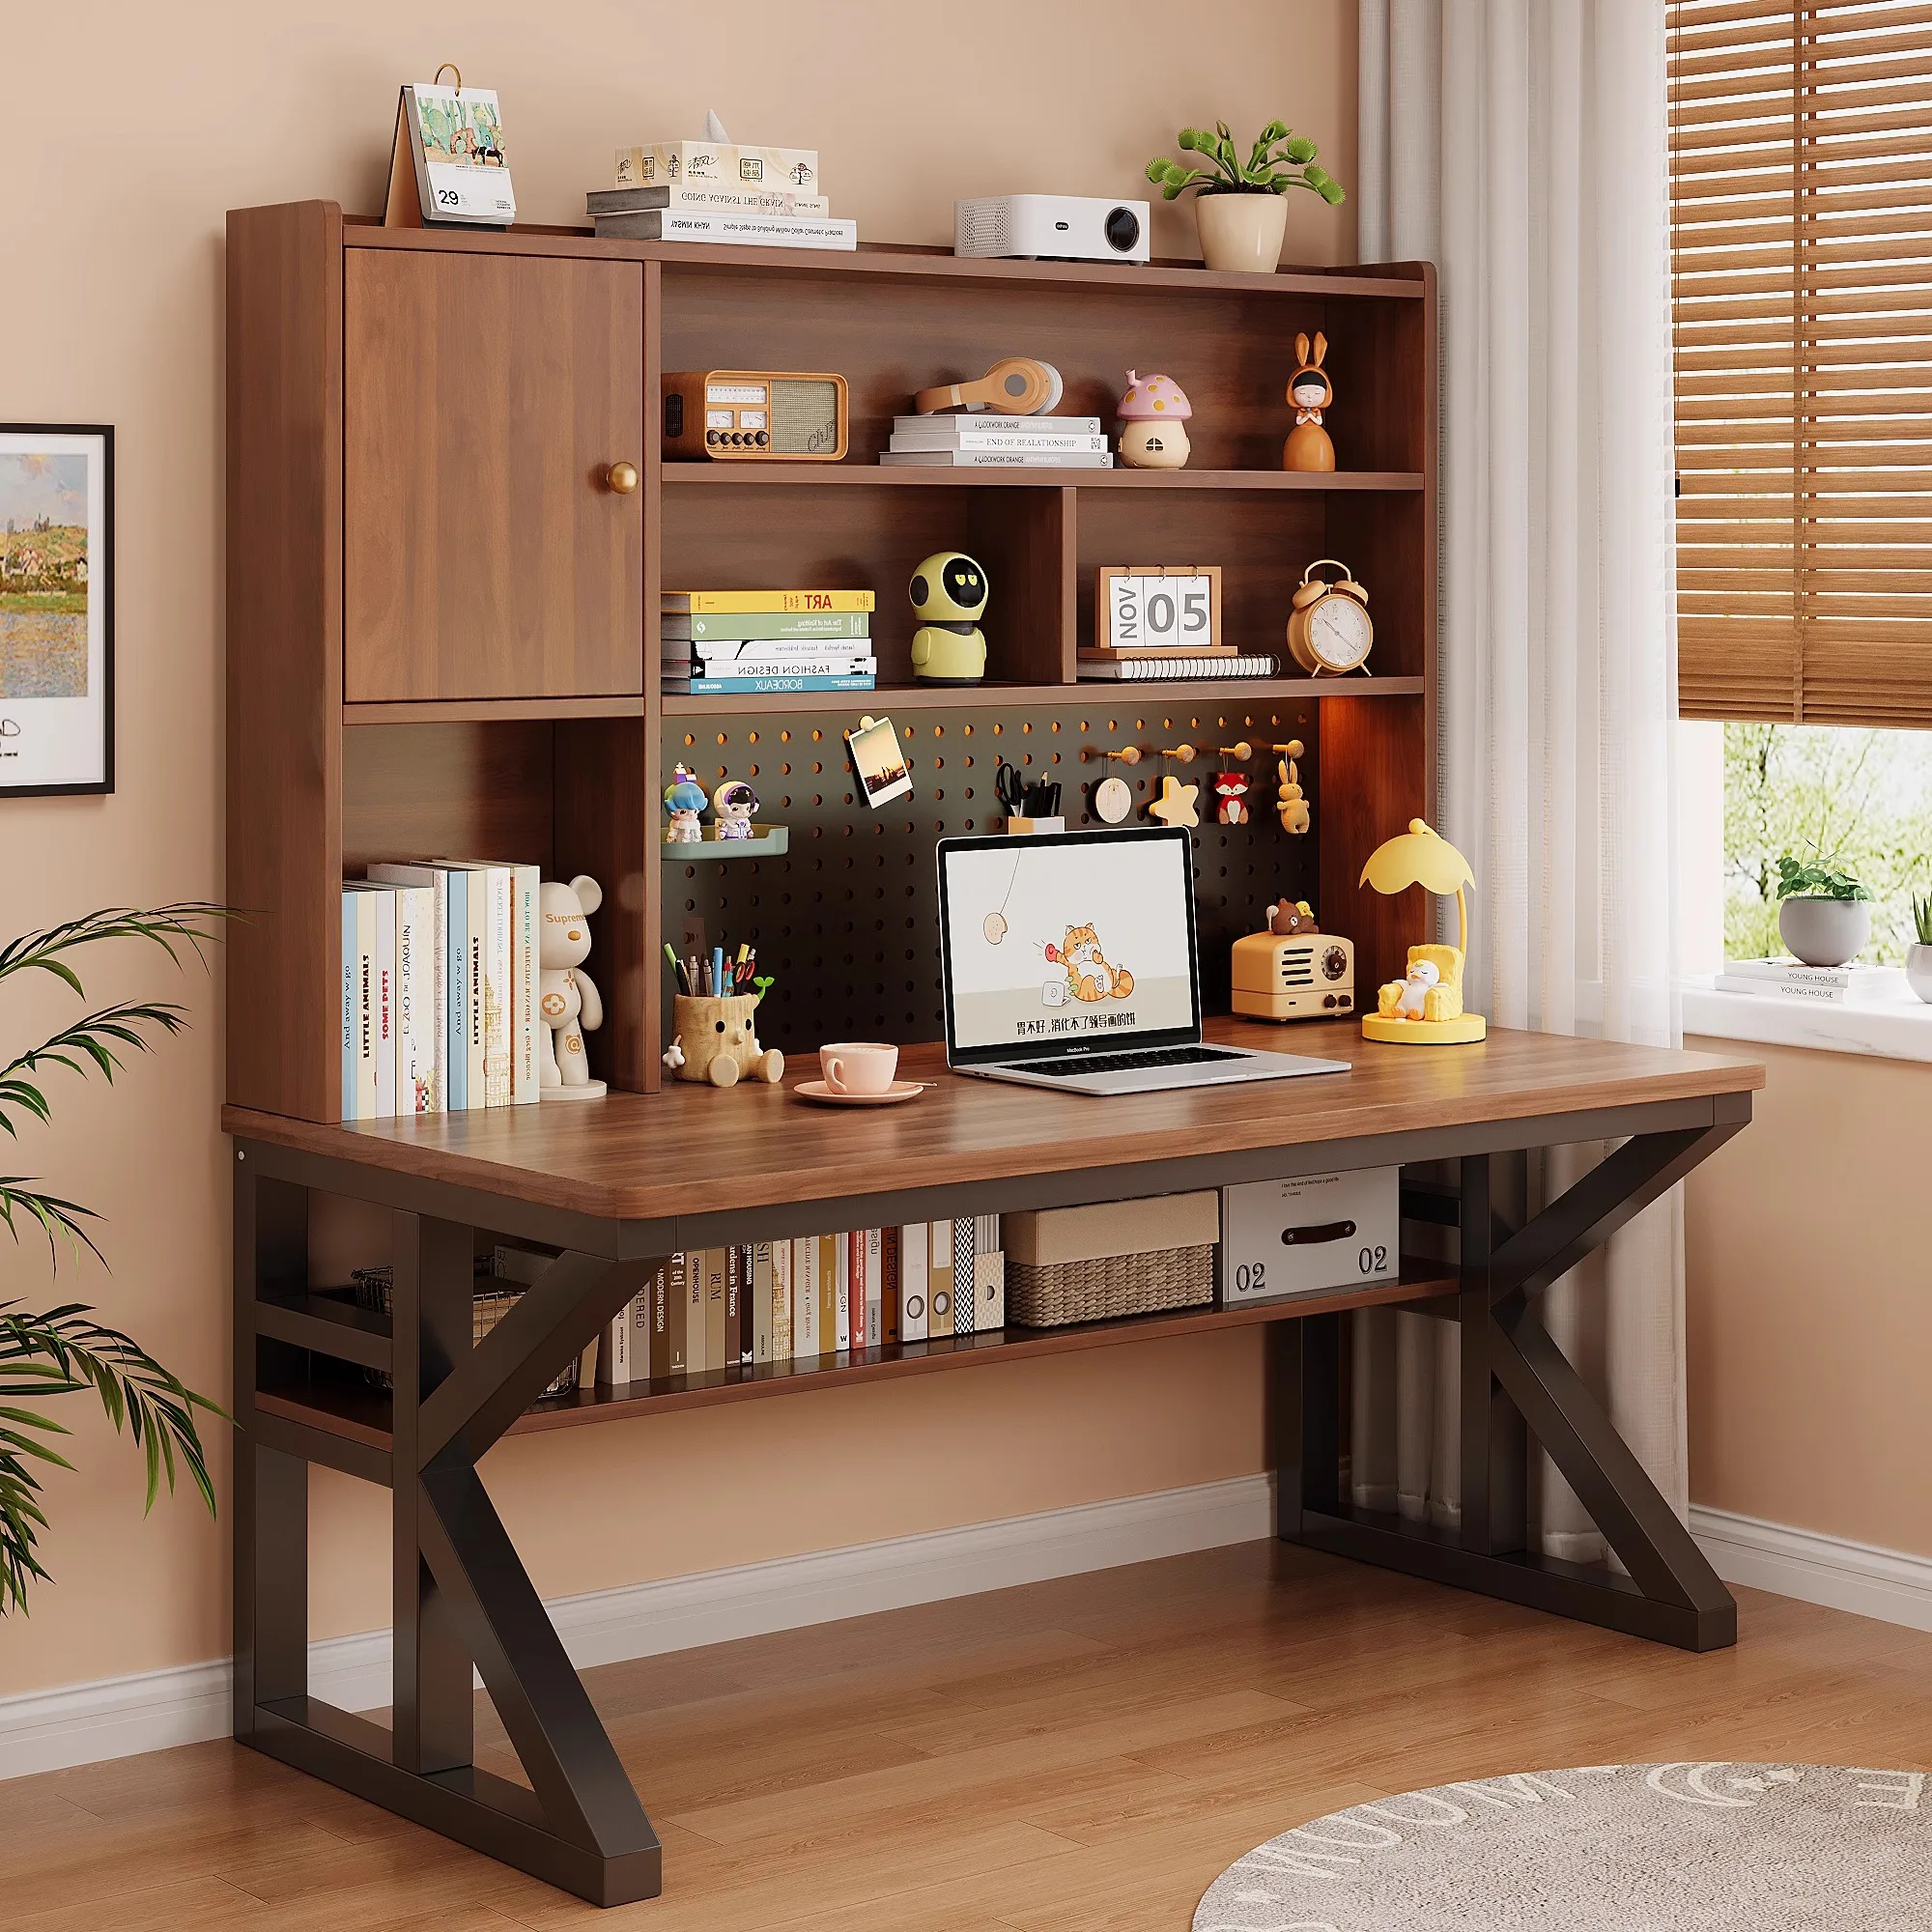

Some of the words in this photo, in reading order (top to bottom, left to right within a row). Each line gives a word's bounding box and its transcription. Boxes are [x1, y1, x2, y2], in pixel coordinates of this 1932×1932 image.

[439, 189, 459, 205] 29
[1016, 439, 1077, 447] REALATIONSHIP
[1119, 587, 1138, 639] NOV
[1147, 593, 1208, 633] 05
[456, 948, 462, 962] go
[345, 965, 352, 979] go
[1787, 972, 1813, 981] YOUNG
[1814, 975, 1838, 983] HOUSE
[1780, 986, 1807, 996] YOUNG
[1808, 989, 1833, 999] HOUSE
[1358, 1245, 1388, 1275] 02
[692, 1257, 700, 1304] OPENHOUSE
[710, 1272, 722, 1301] RUM
[729, 1275, 738, 1285] in
[1236, 1262, 1266, 1293] 02
[729, 1286, 739, 1318] France
